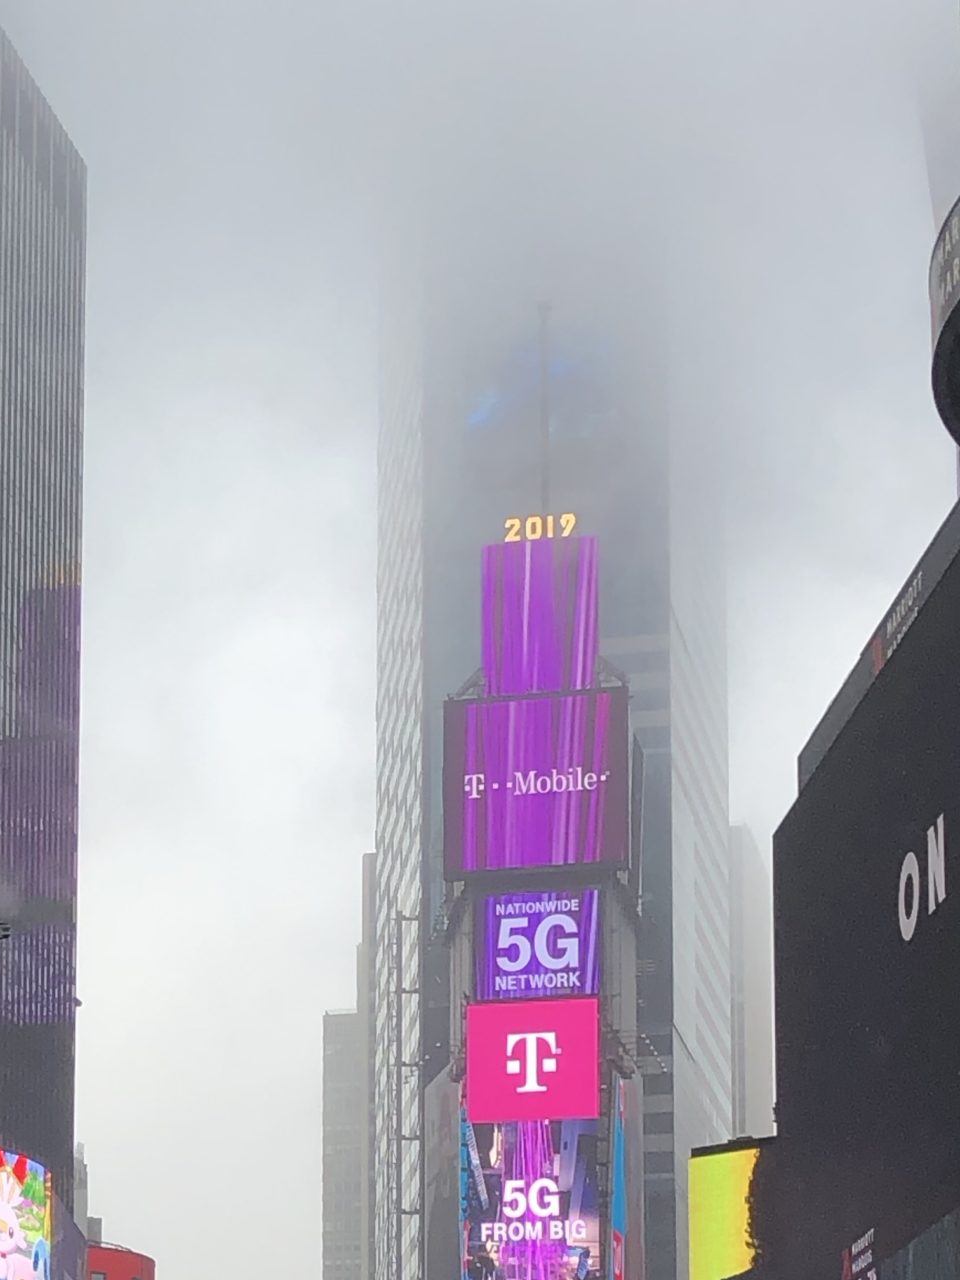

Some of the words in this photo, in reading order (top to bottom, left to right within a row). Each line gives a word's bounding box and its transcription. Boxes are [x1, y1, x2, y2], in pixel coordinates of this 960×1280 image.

[504, 513, 576, 542] 2019
[898, 812, 946, 941] ON
[496, 899, 579, 915] NATIONWIDE
[496, 914, 579, 971] 5G
[495, 972, 581, 991] NETWORK
[502, 1178, 561, 1218] 5G
[481, 1222, 542, 1241] FROM
[549, 1219, 587, 1240] BIG
